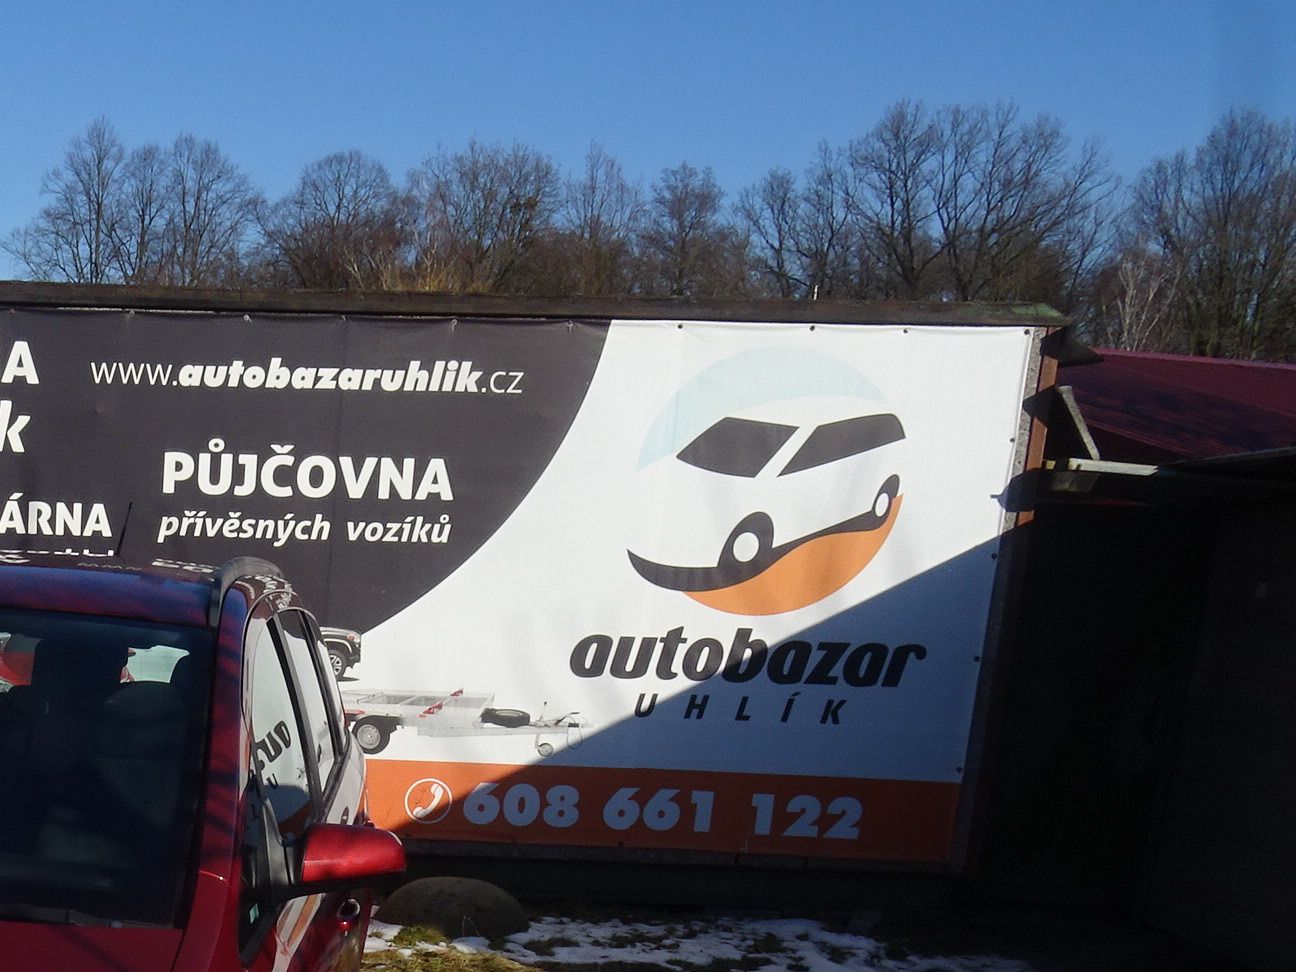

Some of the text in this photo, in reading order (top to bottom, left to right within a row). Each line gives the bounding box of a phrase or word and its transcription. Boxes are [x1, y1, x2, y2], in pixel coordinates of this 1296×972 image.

[91, 357, 524, 395] www.autobazaruhlik.cz
[161, 438, 454, 502] PŮJČOVNA
[158, 511, 452, 547] přívěsných vozíků
[570, 626, 927, 688] autobazar
[462, 783, 862, 840] 608 661 122
